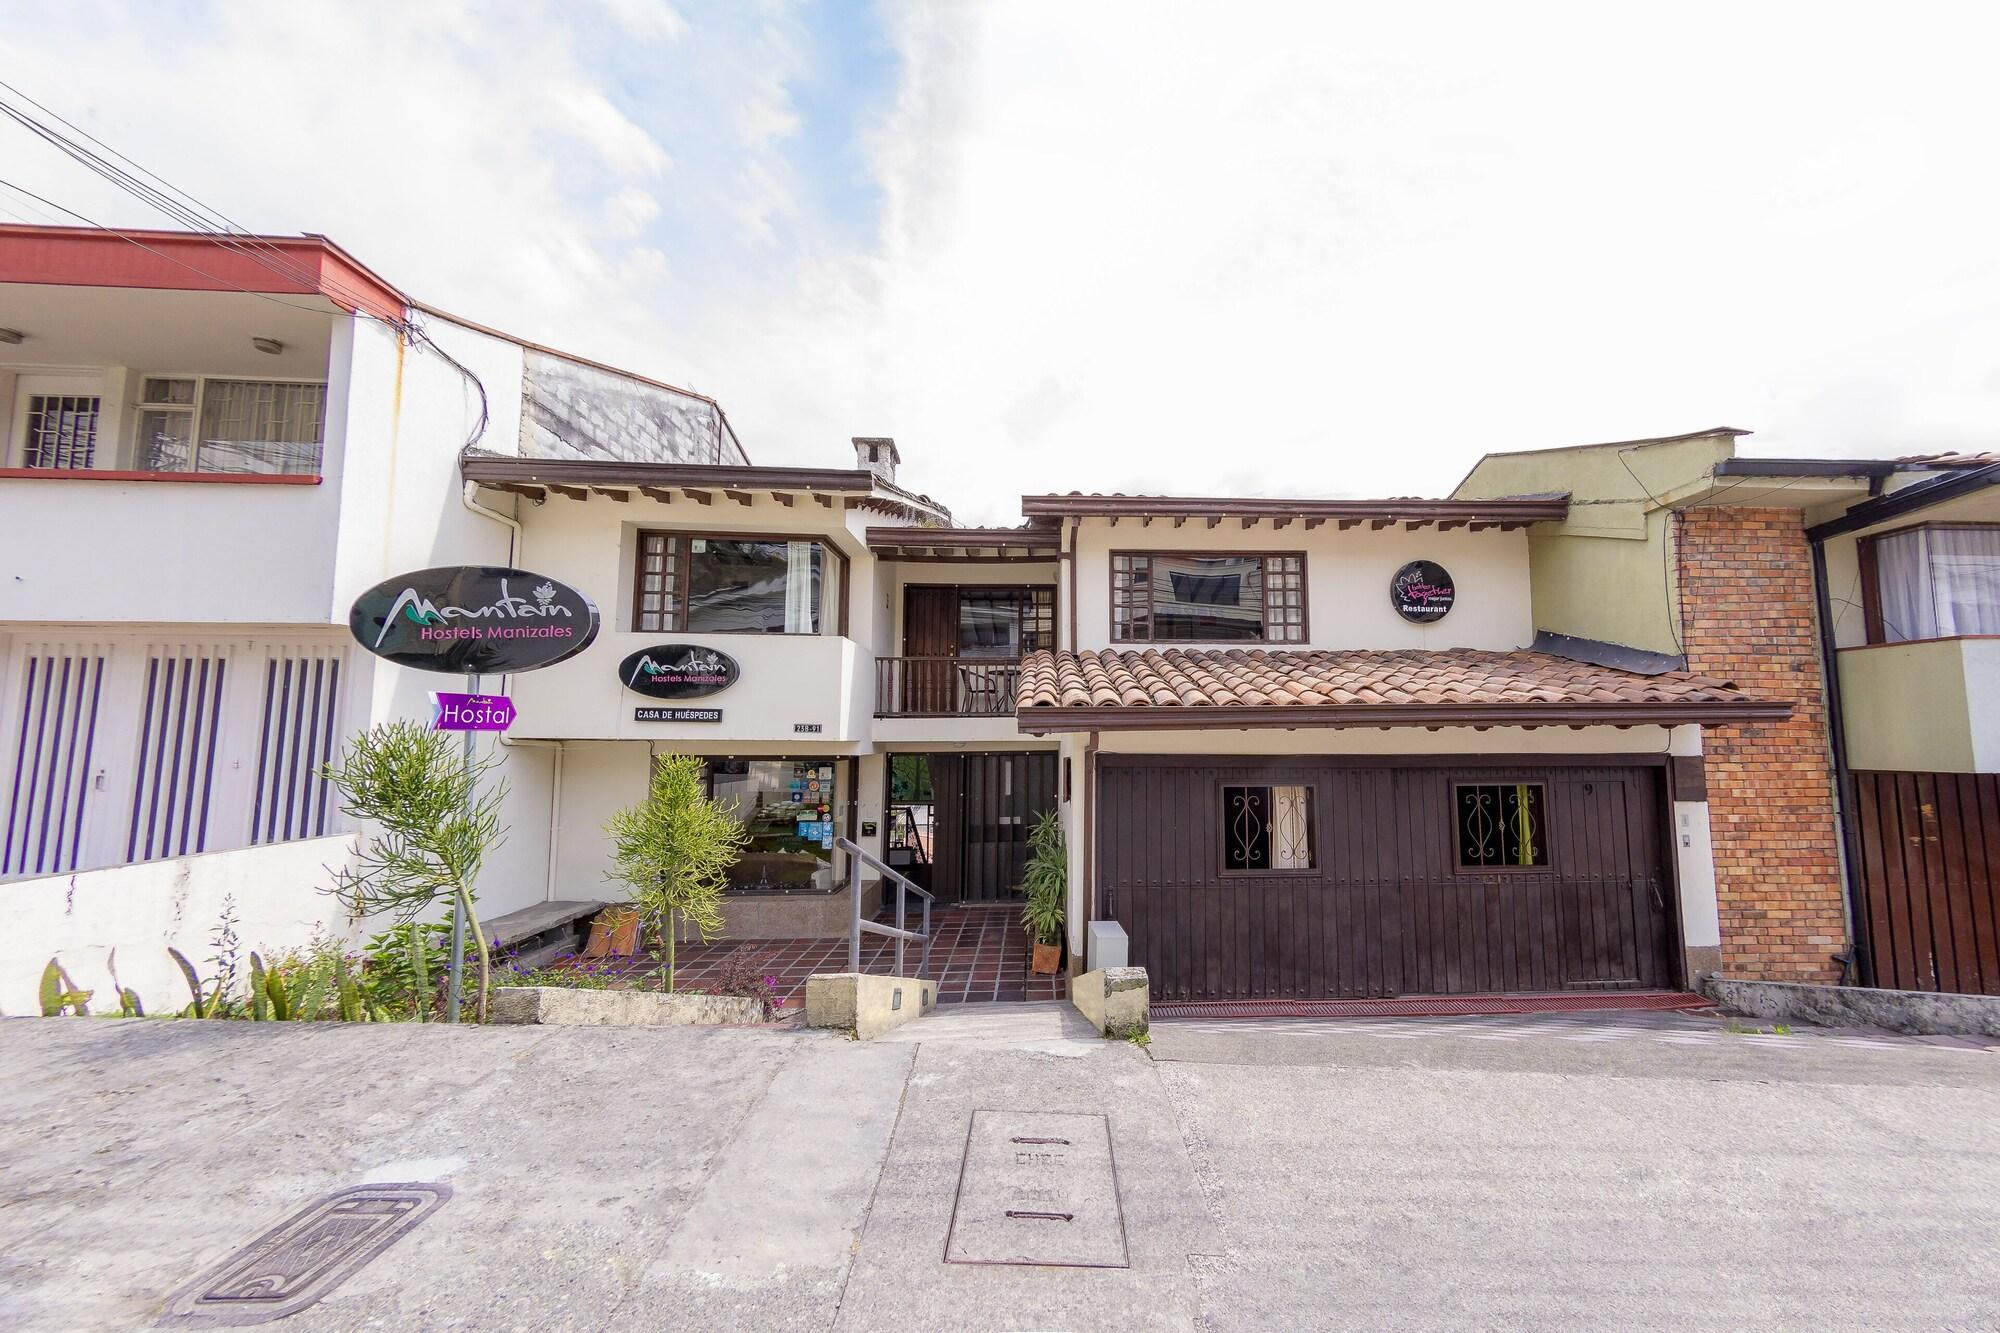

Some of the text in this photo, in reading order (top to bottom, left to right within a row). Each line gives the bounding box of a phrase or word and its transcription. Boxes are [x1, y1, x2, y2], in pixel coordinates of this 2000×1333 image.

[1402, 604, 1447, 613] Restaurant
[420, 625, 572, 640] Hostels Manizales
[651, 674, 726, 683] Hostels Manizales
[444, 704, 510, 724] Hostal
[637, 710, 719, 719] CASA DE HUÉSPEDES
